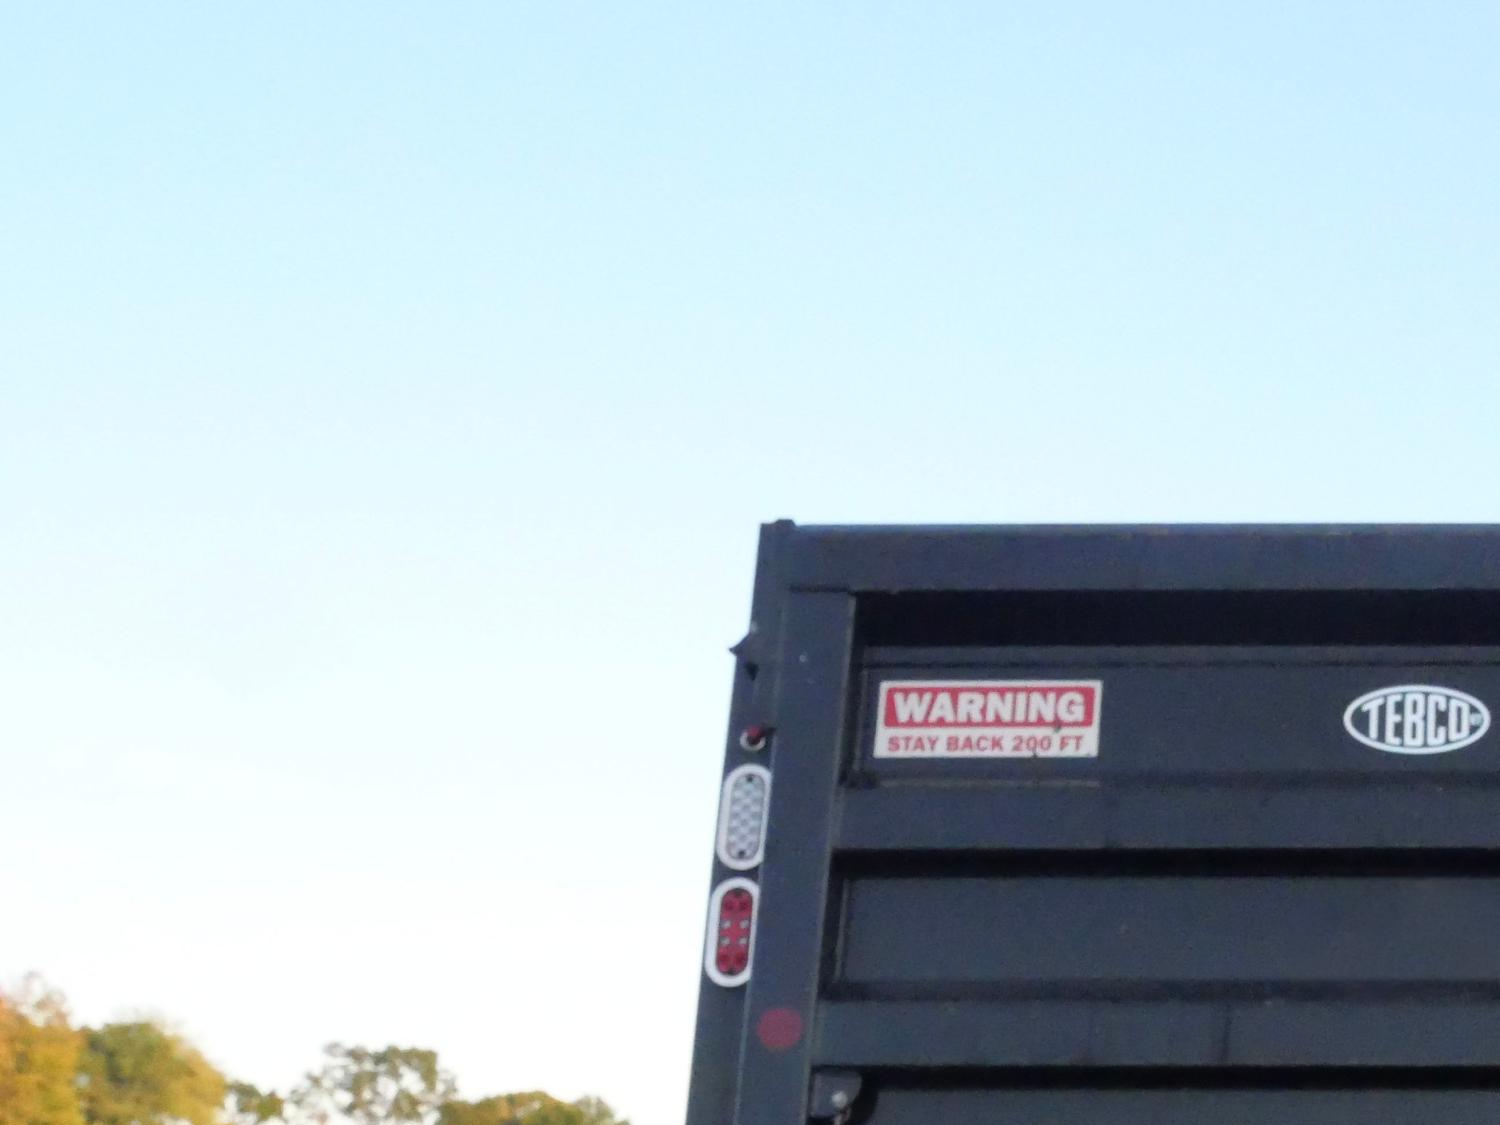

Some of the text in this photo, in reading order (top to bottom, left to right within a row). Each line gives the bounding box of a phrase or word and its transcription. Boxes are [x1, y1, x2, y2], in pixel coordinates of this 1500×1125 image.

[893, 691, 1085, 723] WARNING
[888, 735, 1083, 752] STAY BACK 200 FT
